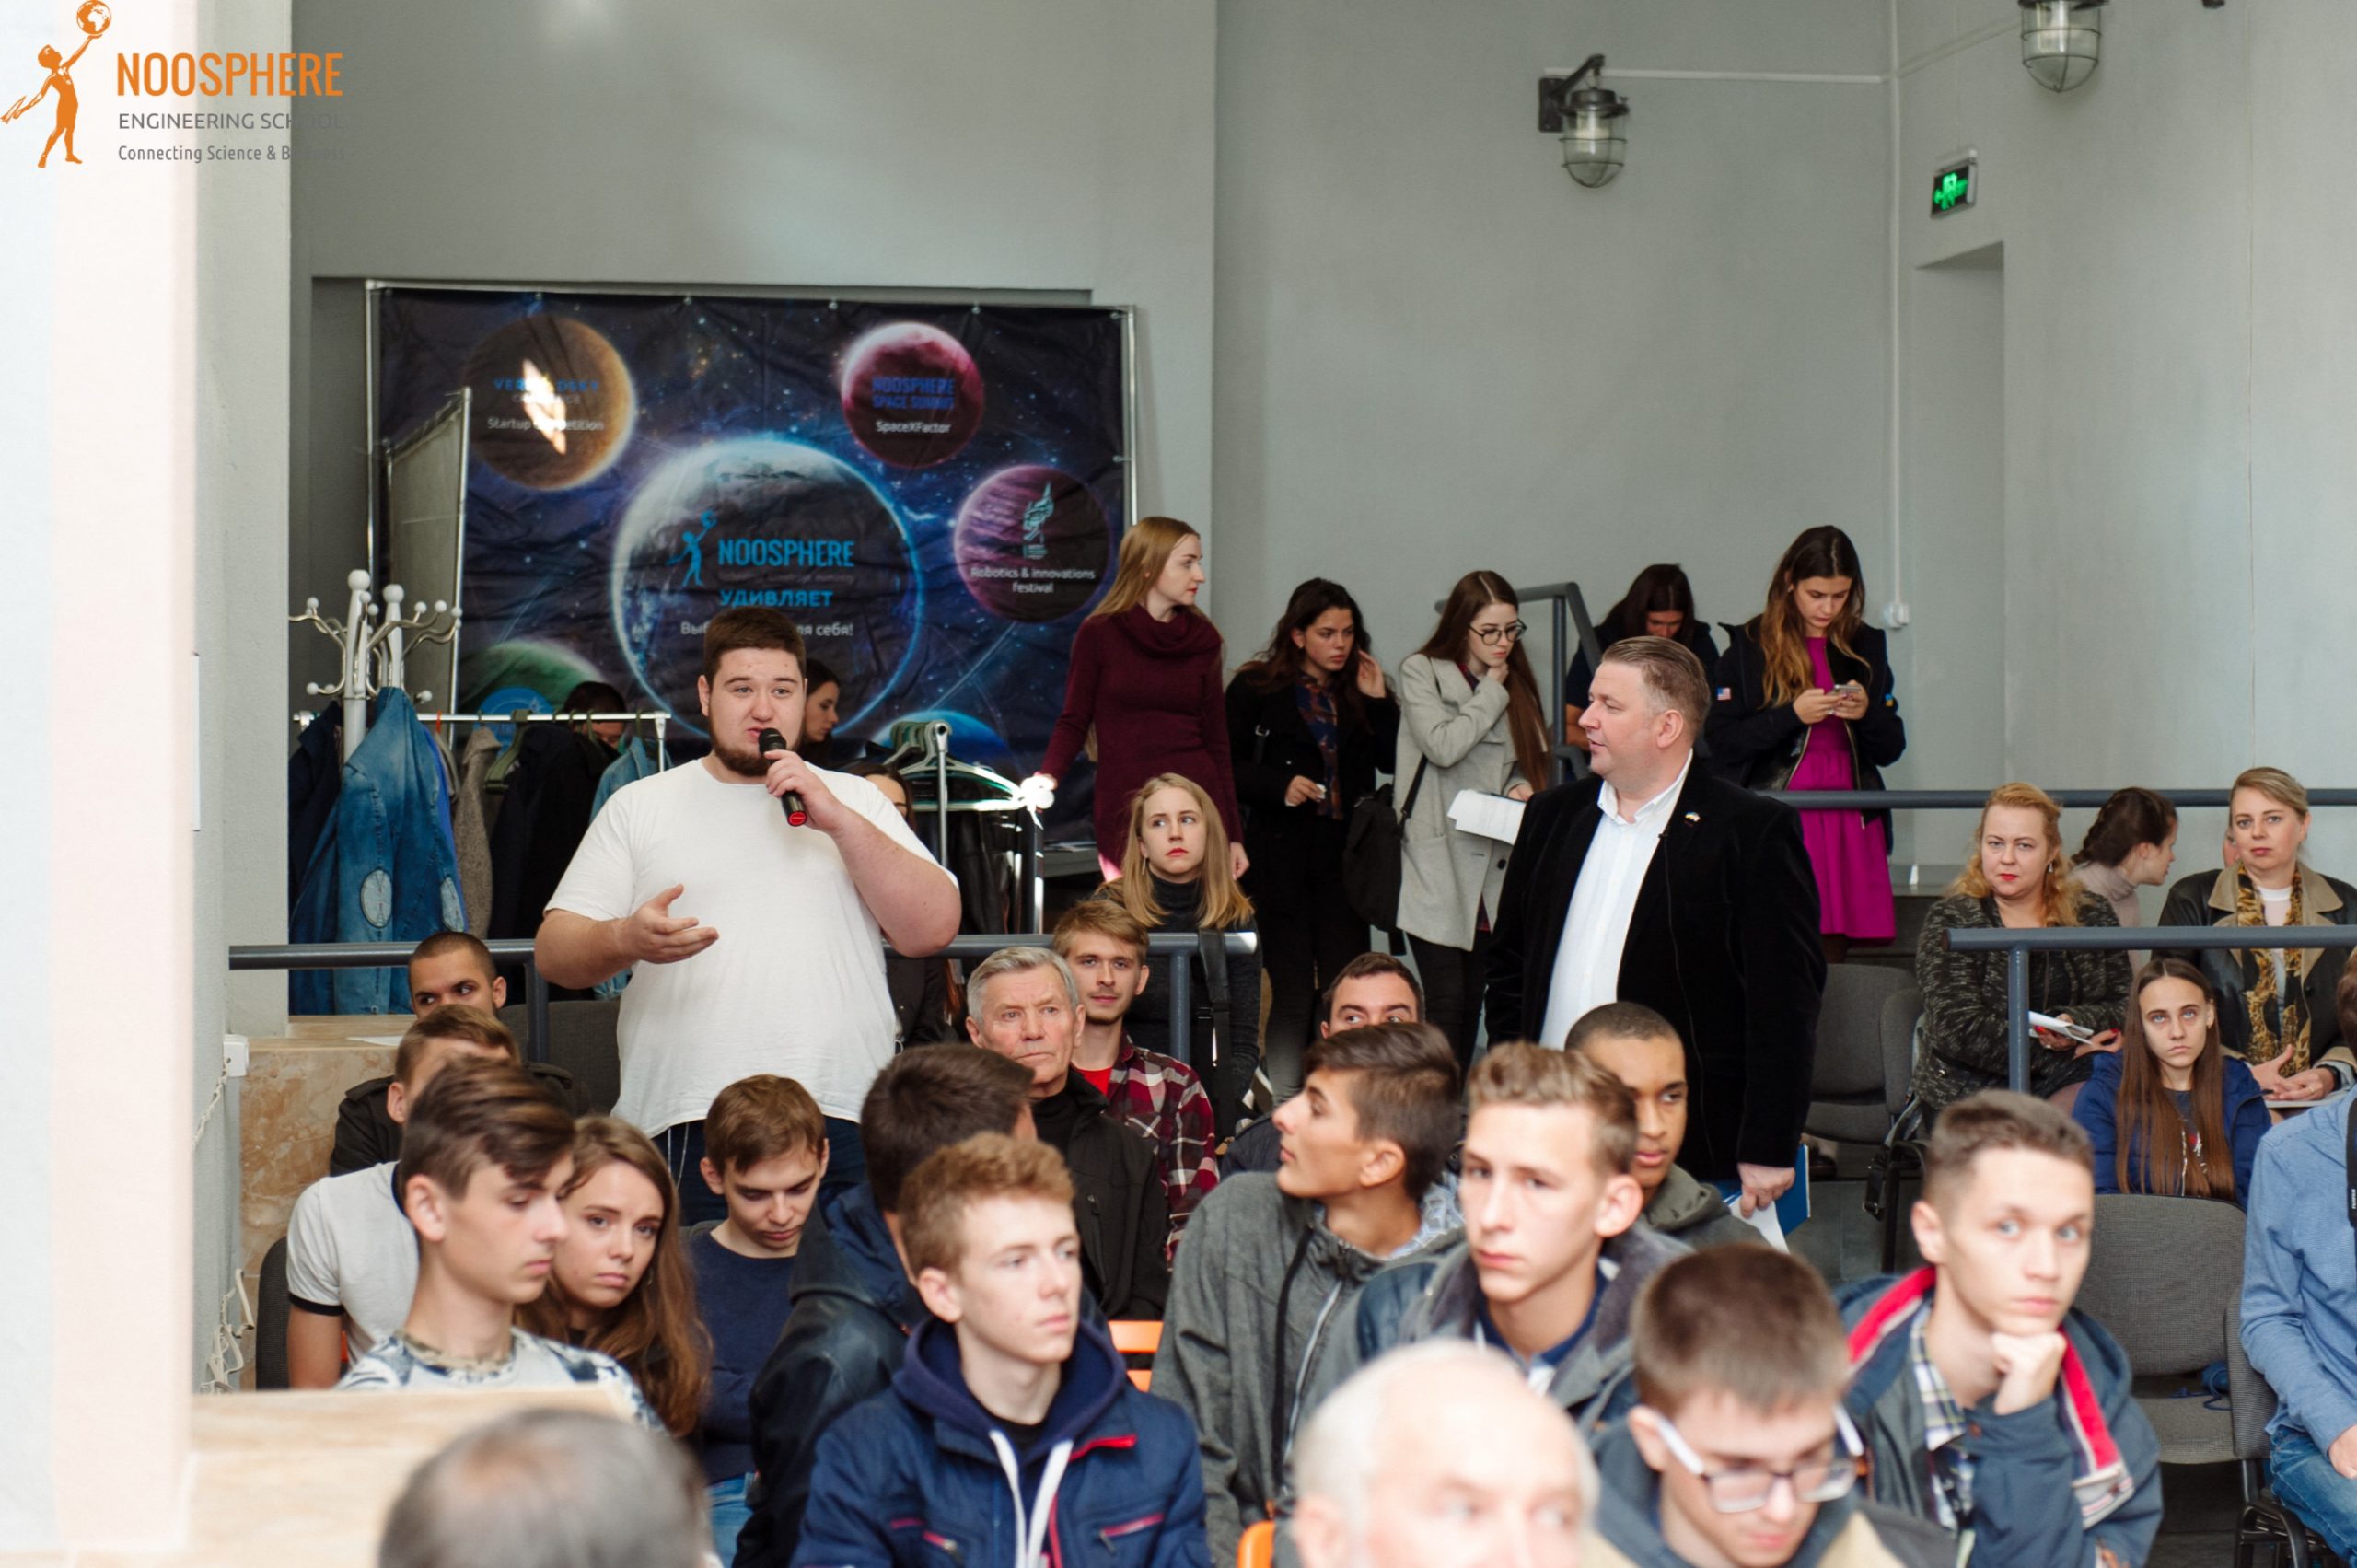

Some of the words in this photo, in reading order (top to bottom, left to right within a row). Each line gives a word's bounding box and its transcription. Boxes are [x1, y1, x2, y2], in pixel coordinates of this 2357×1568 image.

[493, 377, 598, 392] VERDSKY
[872, 377, 956, 394] NOOSPHERE
[487, 416, 532, 431] Startup
[534, 418, 604, 431] etition
[718, 537, 855, 568] NOOSPHERE
[970, 567, 1019, 579] Robotics
[1020, 567, 1030, 578] &
[720, 588, 833, 610] УДИВЛЯЕТ
[816, 622, 853, 636] себя!
